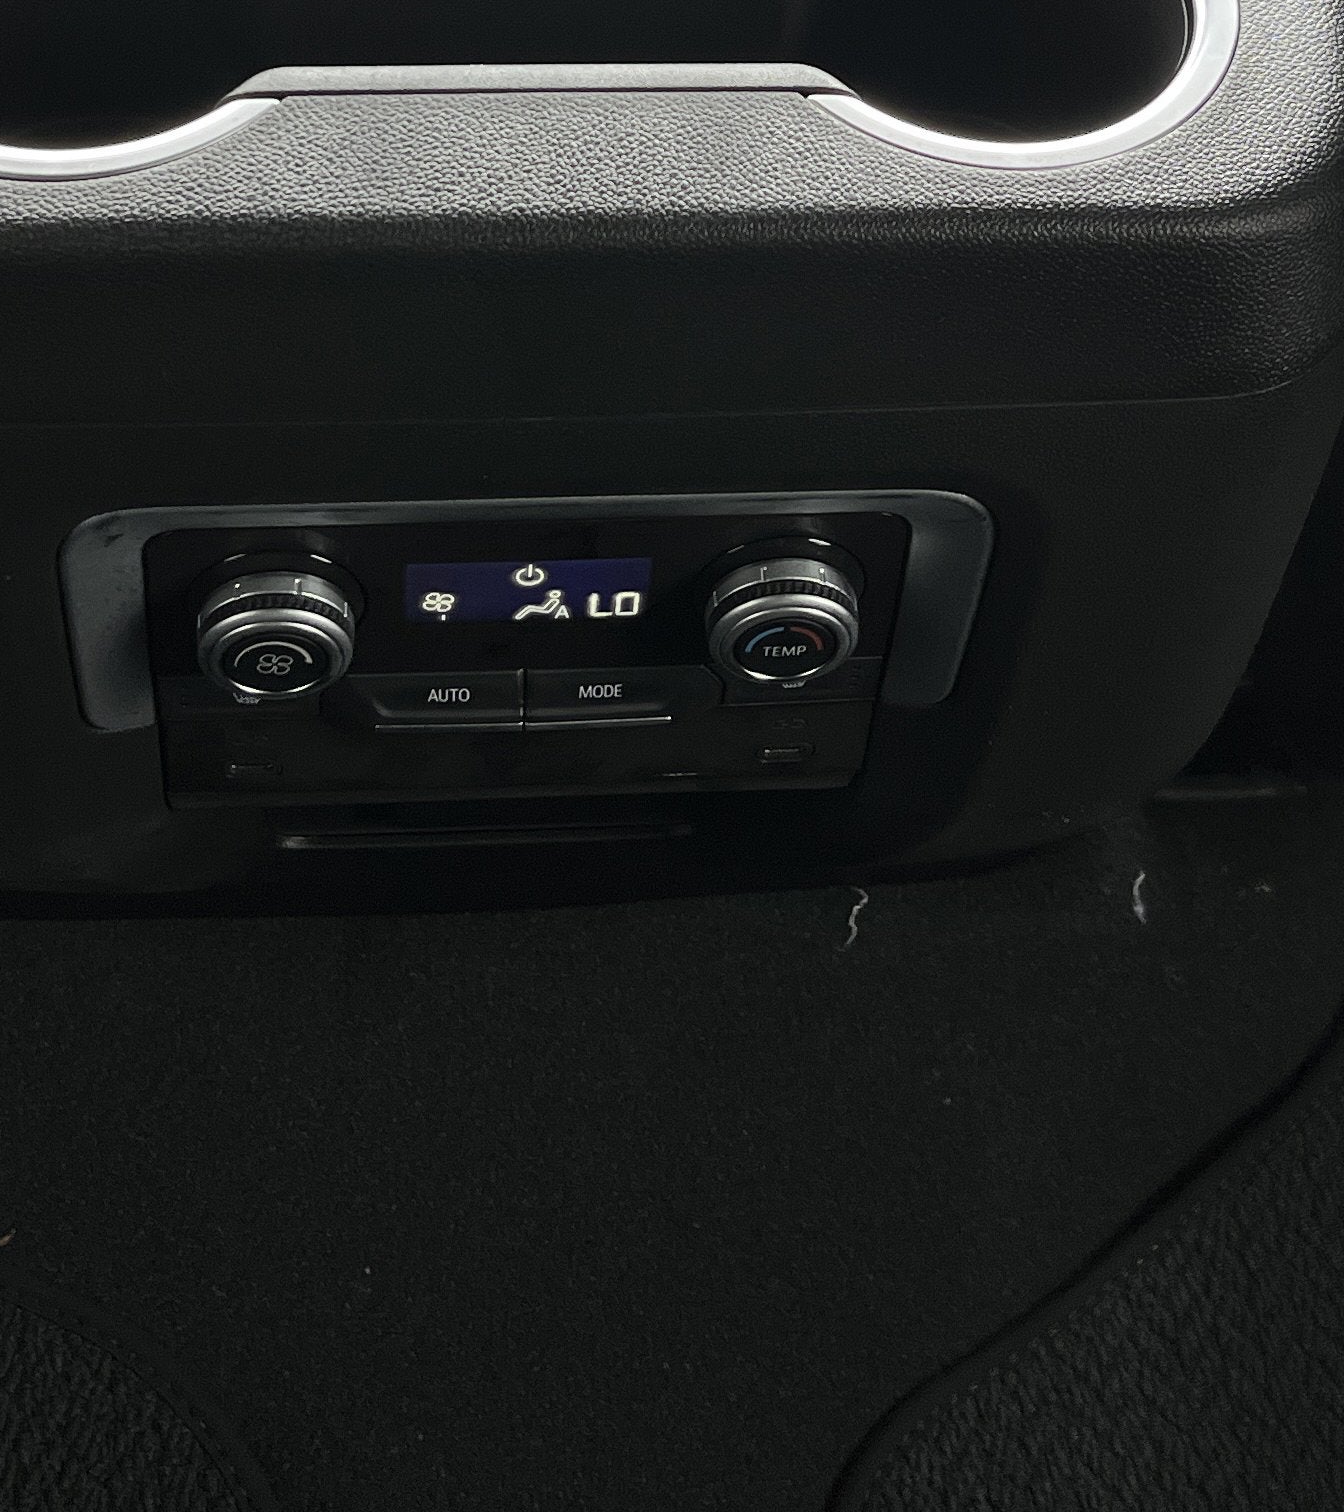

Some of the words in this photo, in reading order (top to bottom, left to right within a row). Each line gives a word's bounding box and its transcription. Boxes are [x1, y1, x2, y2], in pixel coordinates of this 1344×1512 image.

[762, 644, 807, 658] TEMP
[427, 688, 471, 703] AUTO
[578, 684, 623, 699] MODE
